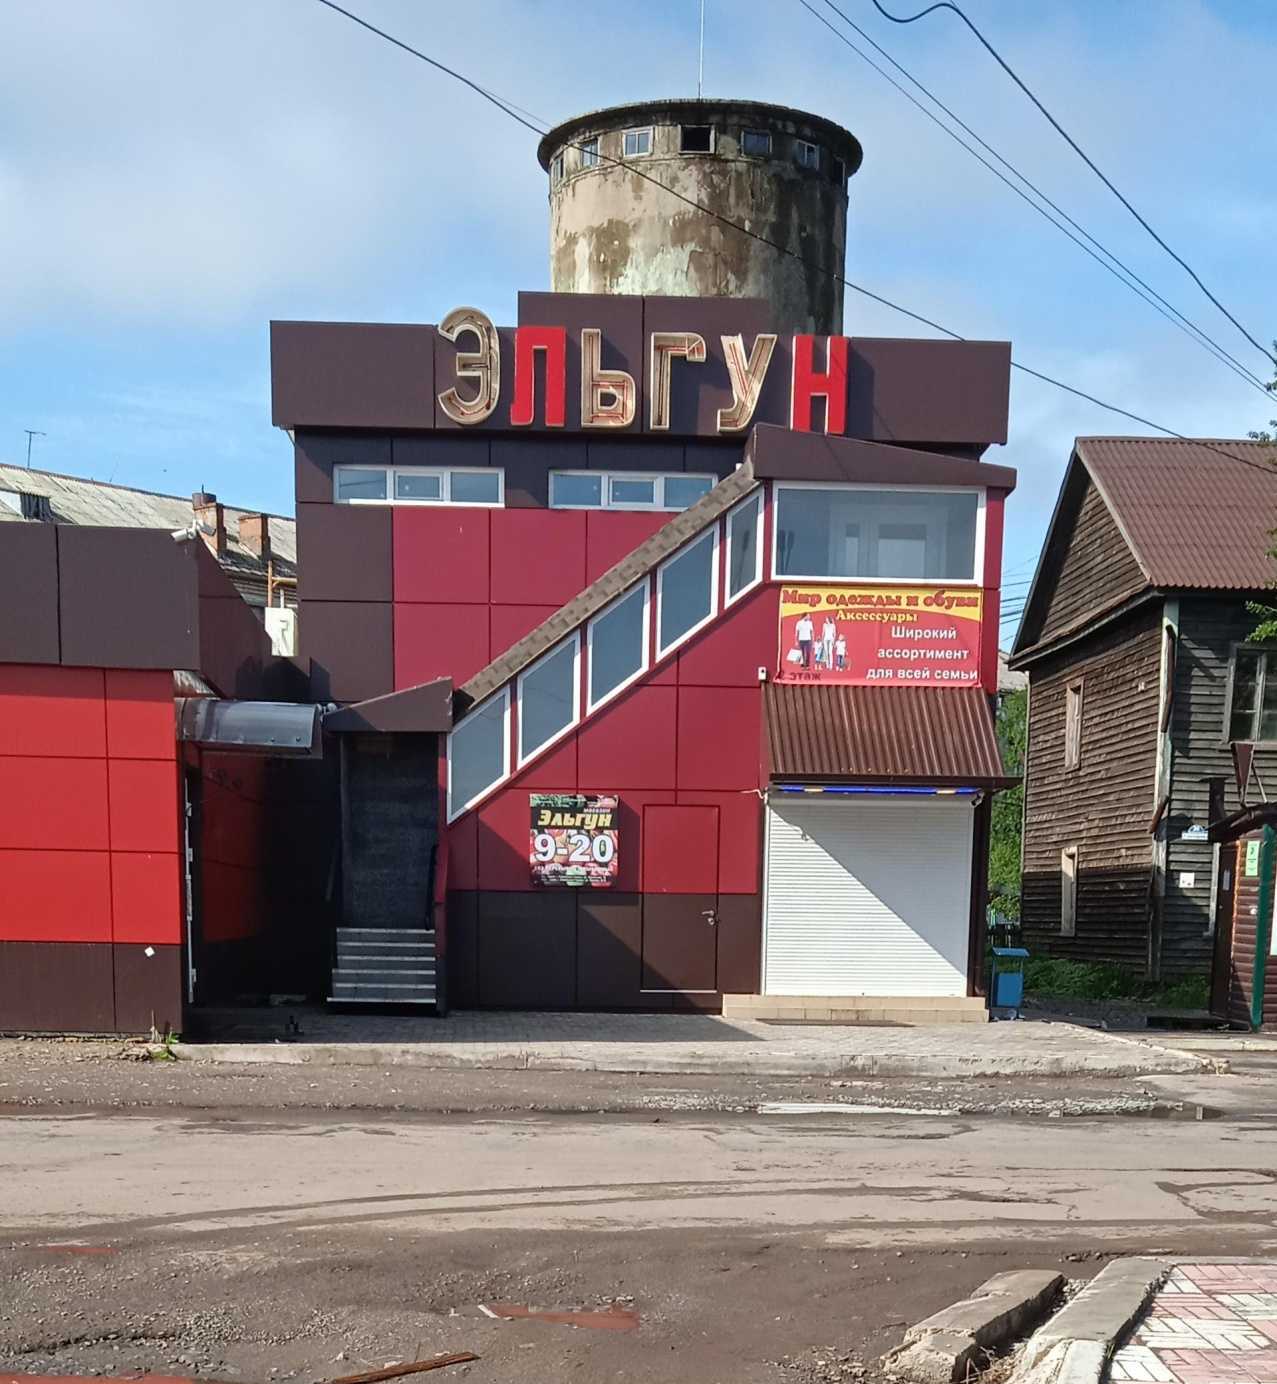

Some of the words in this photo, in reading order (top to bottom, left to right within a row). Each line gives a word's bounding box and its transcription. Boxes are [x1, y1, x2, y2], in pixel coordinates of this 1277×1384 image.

[782, 590, 821, 607] Мир
[826, 595, 902, 608] одежды
[906, 595, 918, 607] и
[923, 590, 979, 609] обуви
[835, 609, 918, 623] Аксессуары
[891, 626, 957, 641] Широкий
[877, 648, 969, 662] ассортимент
[866, 669, 891, 681] для
[897, 667, 930, 680] всей
[934, 669, 979, 681] семьи
[538, 809, 613, 830] Эльгун
[534, 833, 614, 863] 9-20
